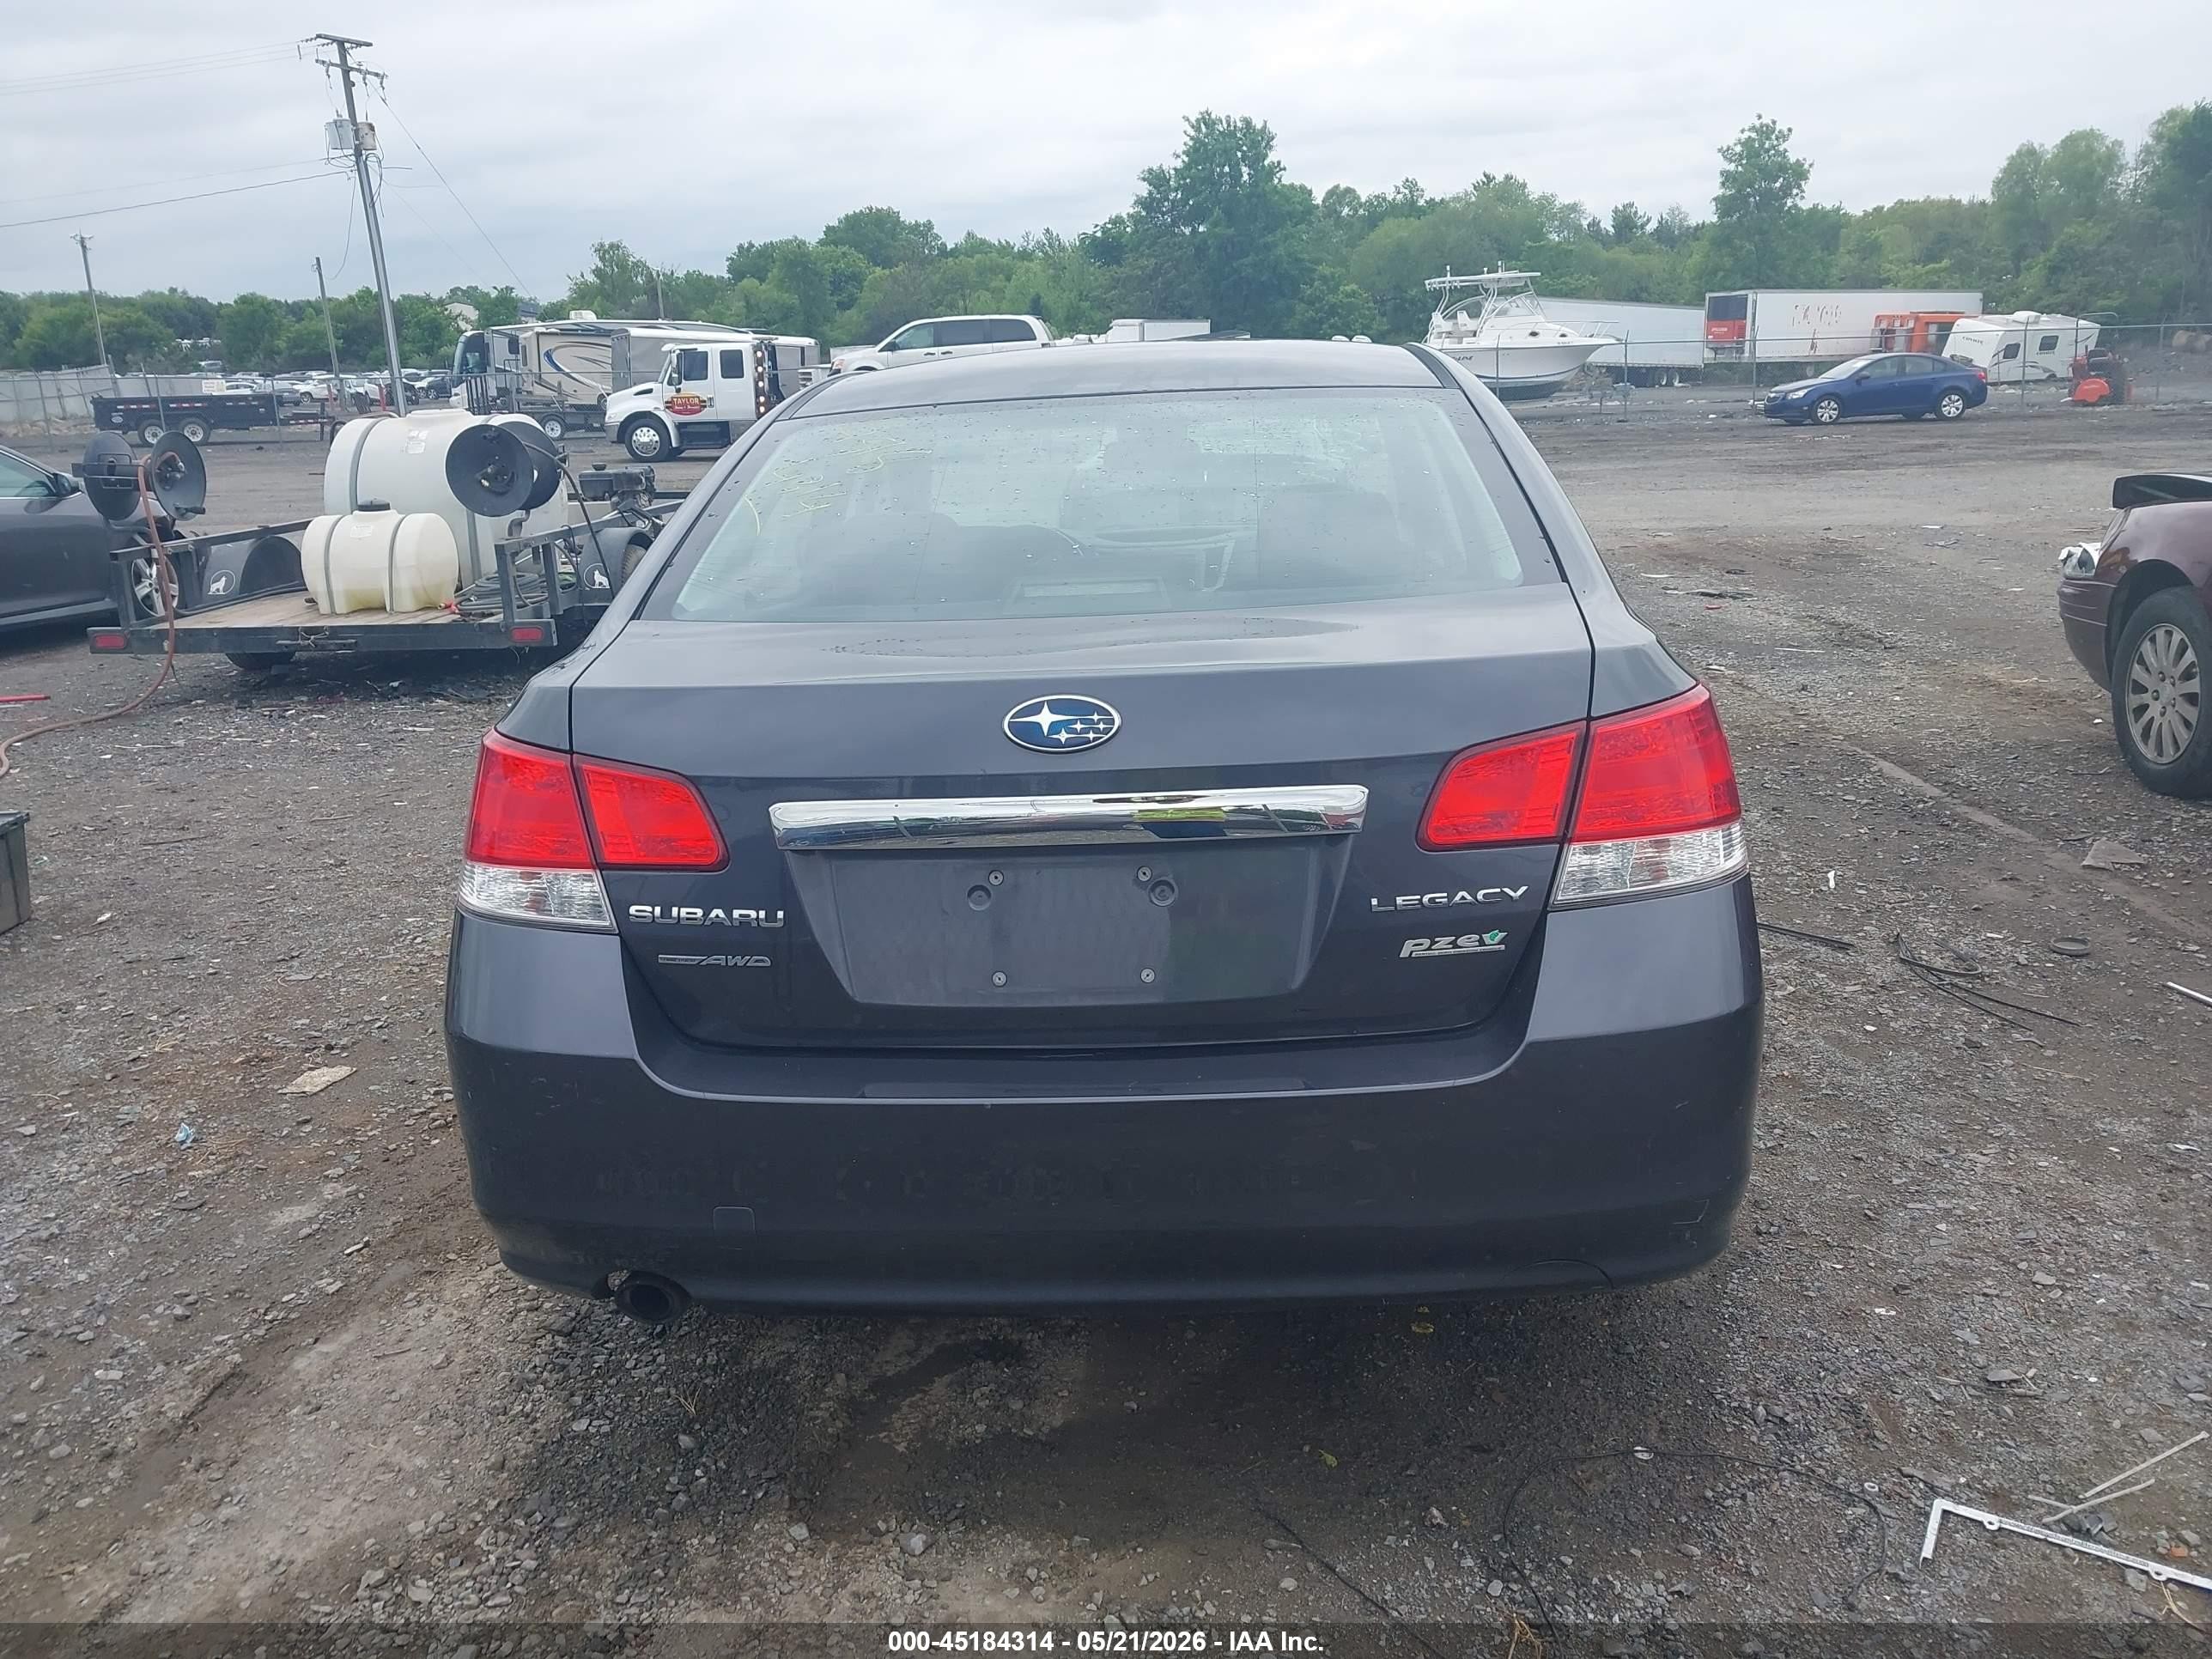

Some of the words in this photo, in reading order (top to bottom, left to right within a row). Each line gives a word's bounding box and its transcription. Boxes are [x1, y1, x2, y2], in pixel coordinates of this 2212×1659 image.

[1370, 885, 1528, 912] LEGACY
[629, 904, 784, 927] SUBARU
[699, 955, 771, 967] AWD
